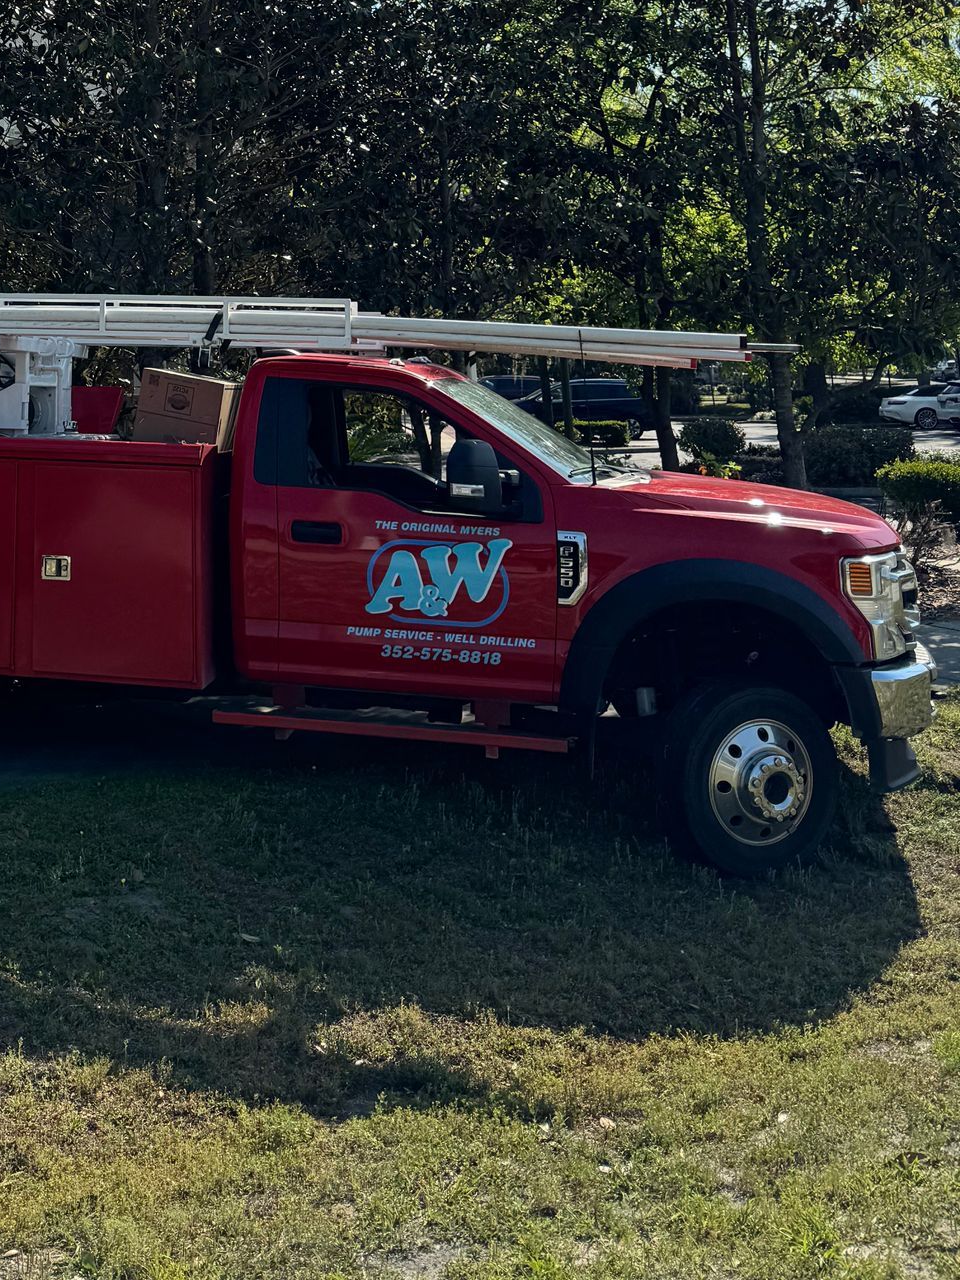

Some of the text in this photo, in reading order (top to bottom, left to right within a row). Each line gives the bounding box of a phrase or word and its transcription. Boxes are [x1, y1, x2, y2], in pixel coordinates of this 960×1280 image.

[375, 520, 501, 536] THE ORIGINAL MYERS
[365, 538, 513, 617] A&W
[347, 626, 381, 637] PUMP
[384, 629, 434, 641] SERVICE
[444, 633, 476, 644] WELL
[479, 636, 536, 648] DRILLING
[380, 644, 502, 665] 352-575-8818
